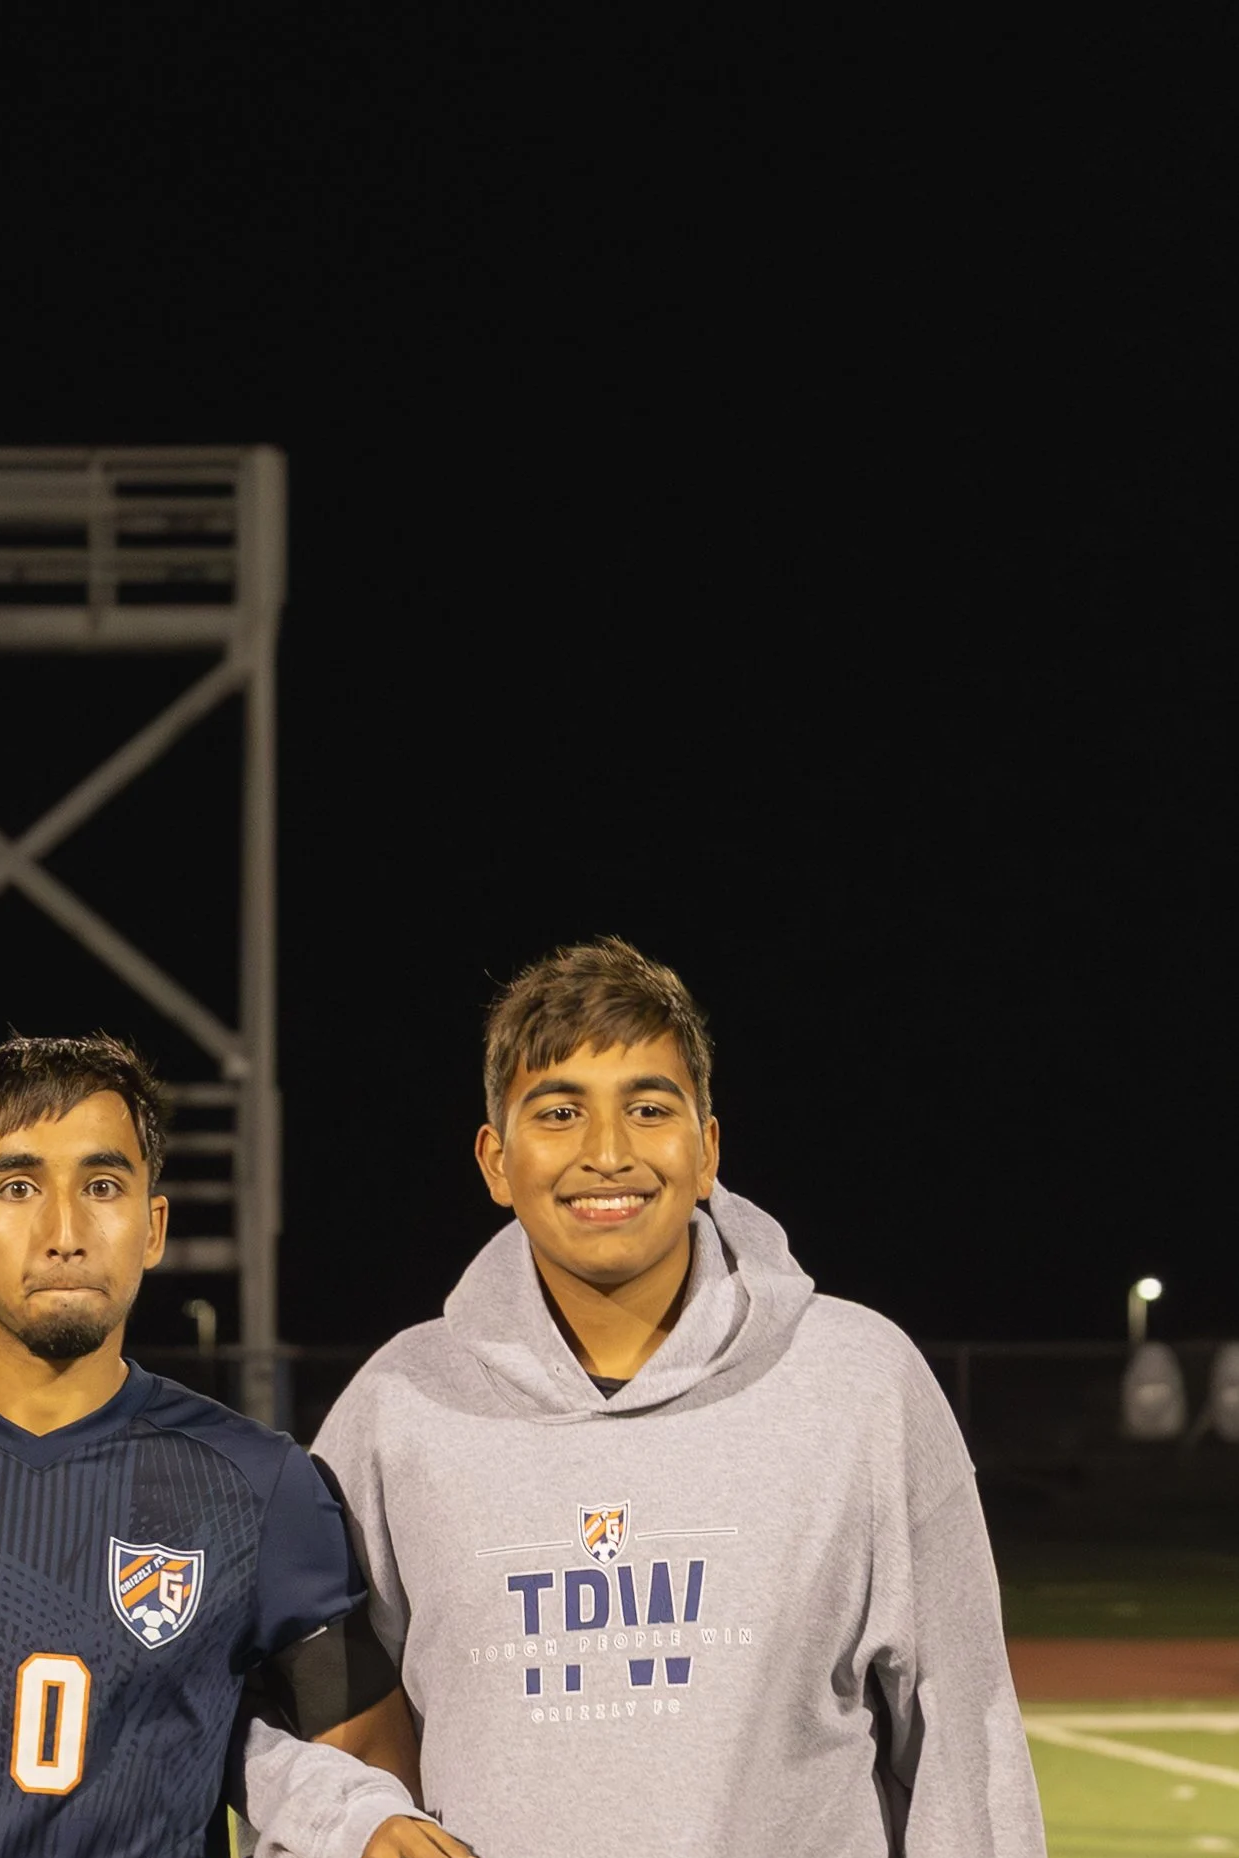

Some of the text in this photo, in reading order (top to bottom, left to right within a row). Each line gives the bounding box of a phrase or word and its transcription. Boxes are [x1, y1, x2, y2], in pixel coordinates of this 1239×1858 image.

[605, 1518, 620, 1547] G
[119, 1555, 166, 1595] GRIZZLY FC
[158, 1569, 184, 1615] G
[469, 1627, 753, 1664] TOUGH PEOPLE WIN
[531, 1699, 681, 1723] GRIZZLY FC
